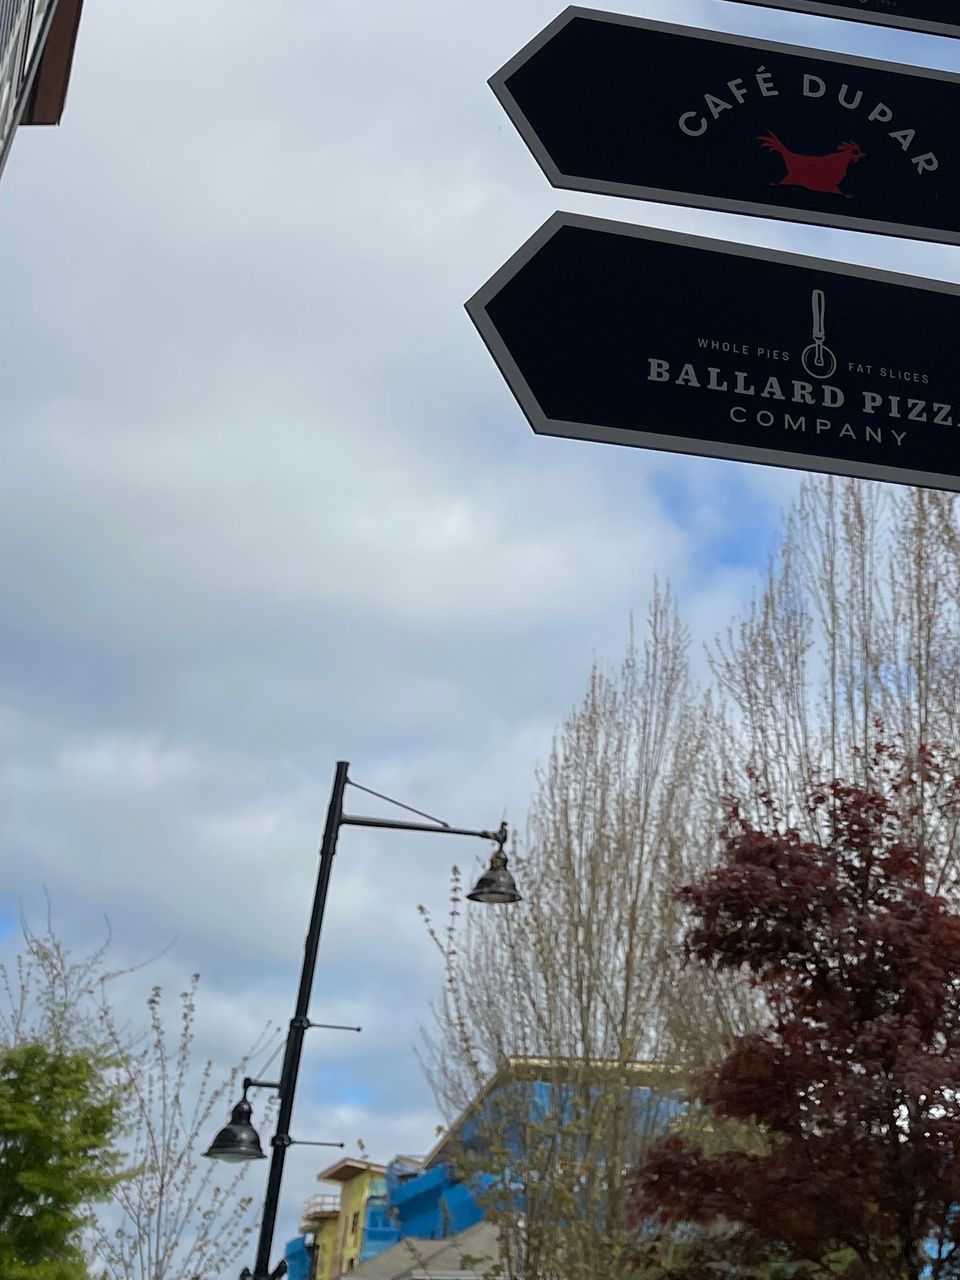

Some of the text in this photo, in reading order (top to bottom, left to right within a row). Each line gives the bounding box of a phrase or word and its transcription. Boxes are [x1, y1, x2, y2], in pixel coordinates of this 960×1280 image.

[678, 65, 779, 137] CAFÉ
[647, 357, 845, 409] BALLARD
[697, 337, 930, 384] WHOLE PIES FAT SLICES
[729, 406, 908, 447] COMPANY
